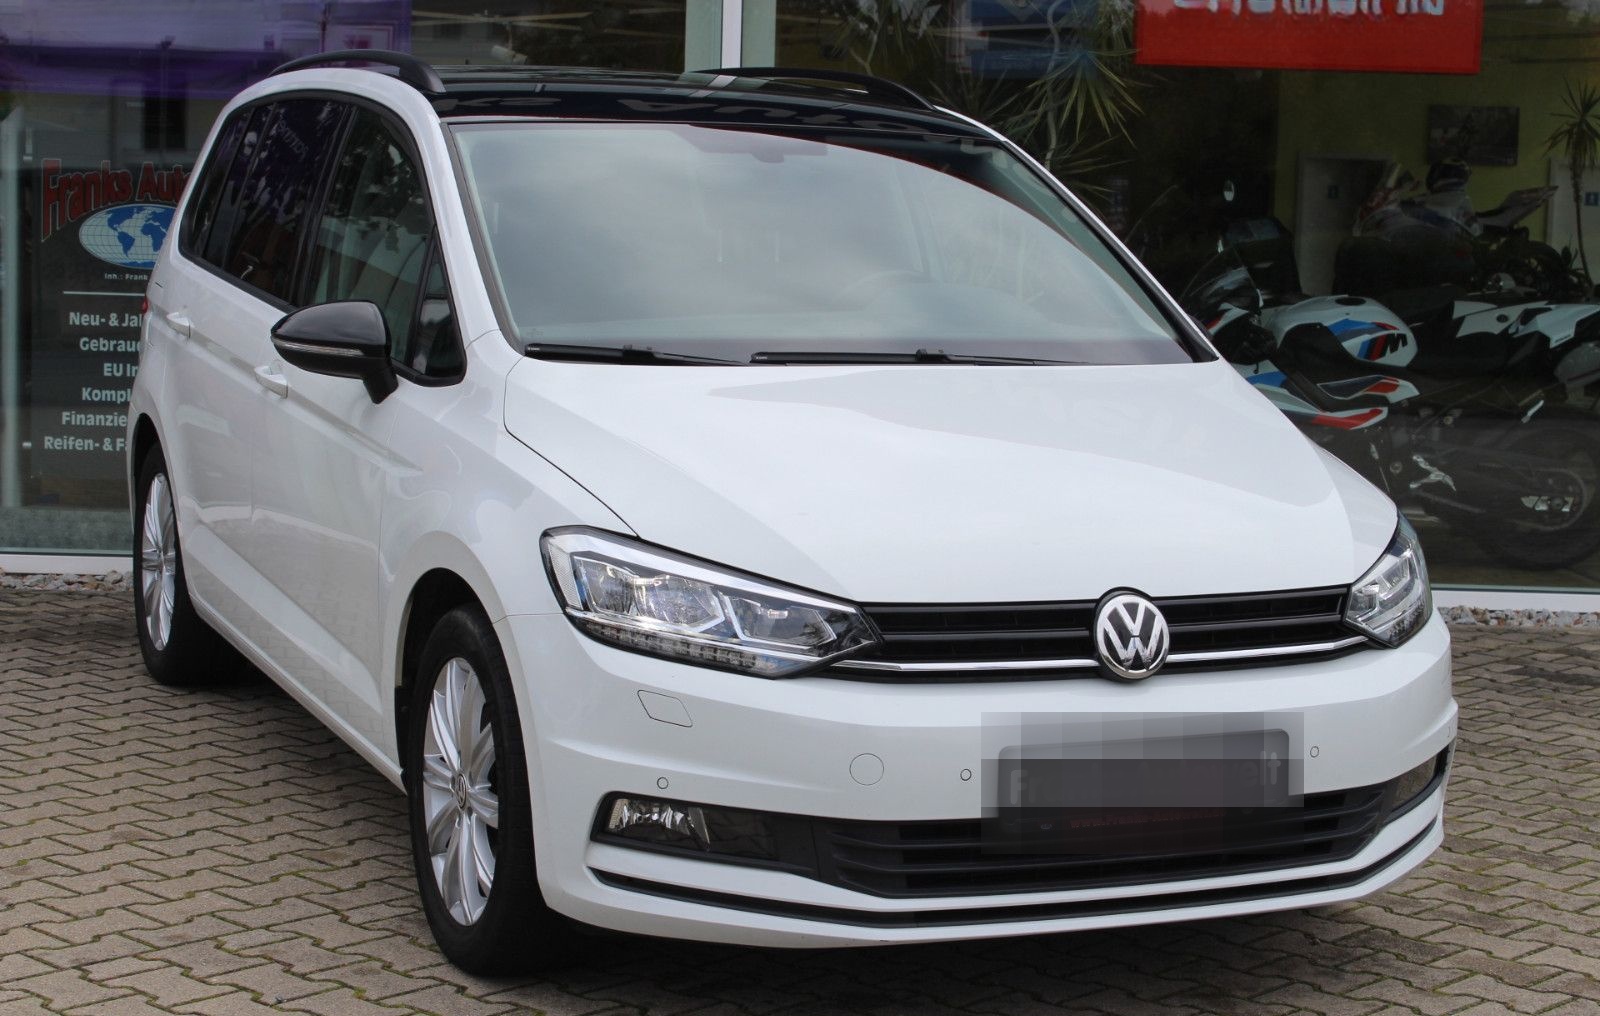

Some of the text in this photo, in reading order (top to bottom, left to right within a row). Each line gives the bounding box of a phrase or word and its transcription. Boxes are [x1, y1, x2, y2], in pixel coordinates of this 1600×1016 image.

[41, 158, 133, 243] Franks
[69, 312, 105, 326] Neu-
[109, 313, 119, 327] &
[103, 363, 123, 377] EU
[62, 411, 128, 427] Finanzie
[44, 436, 99, 451] Reifen-
[103, 438, 113, 451] &
